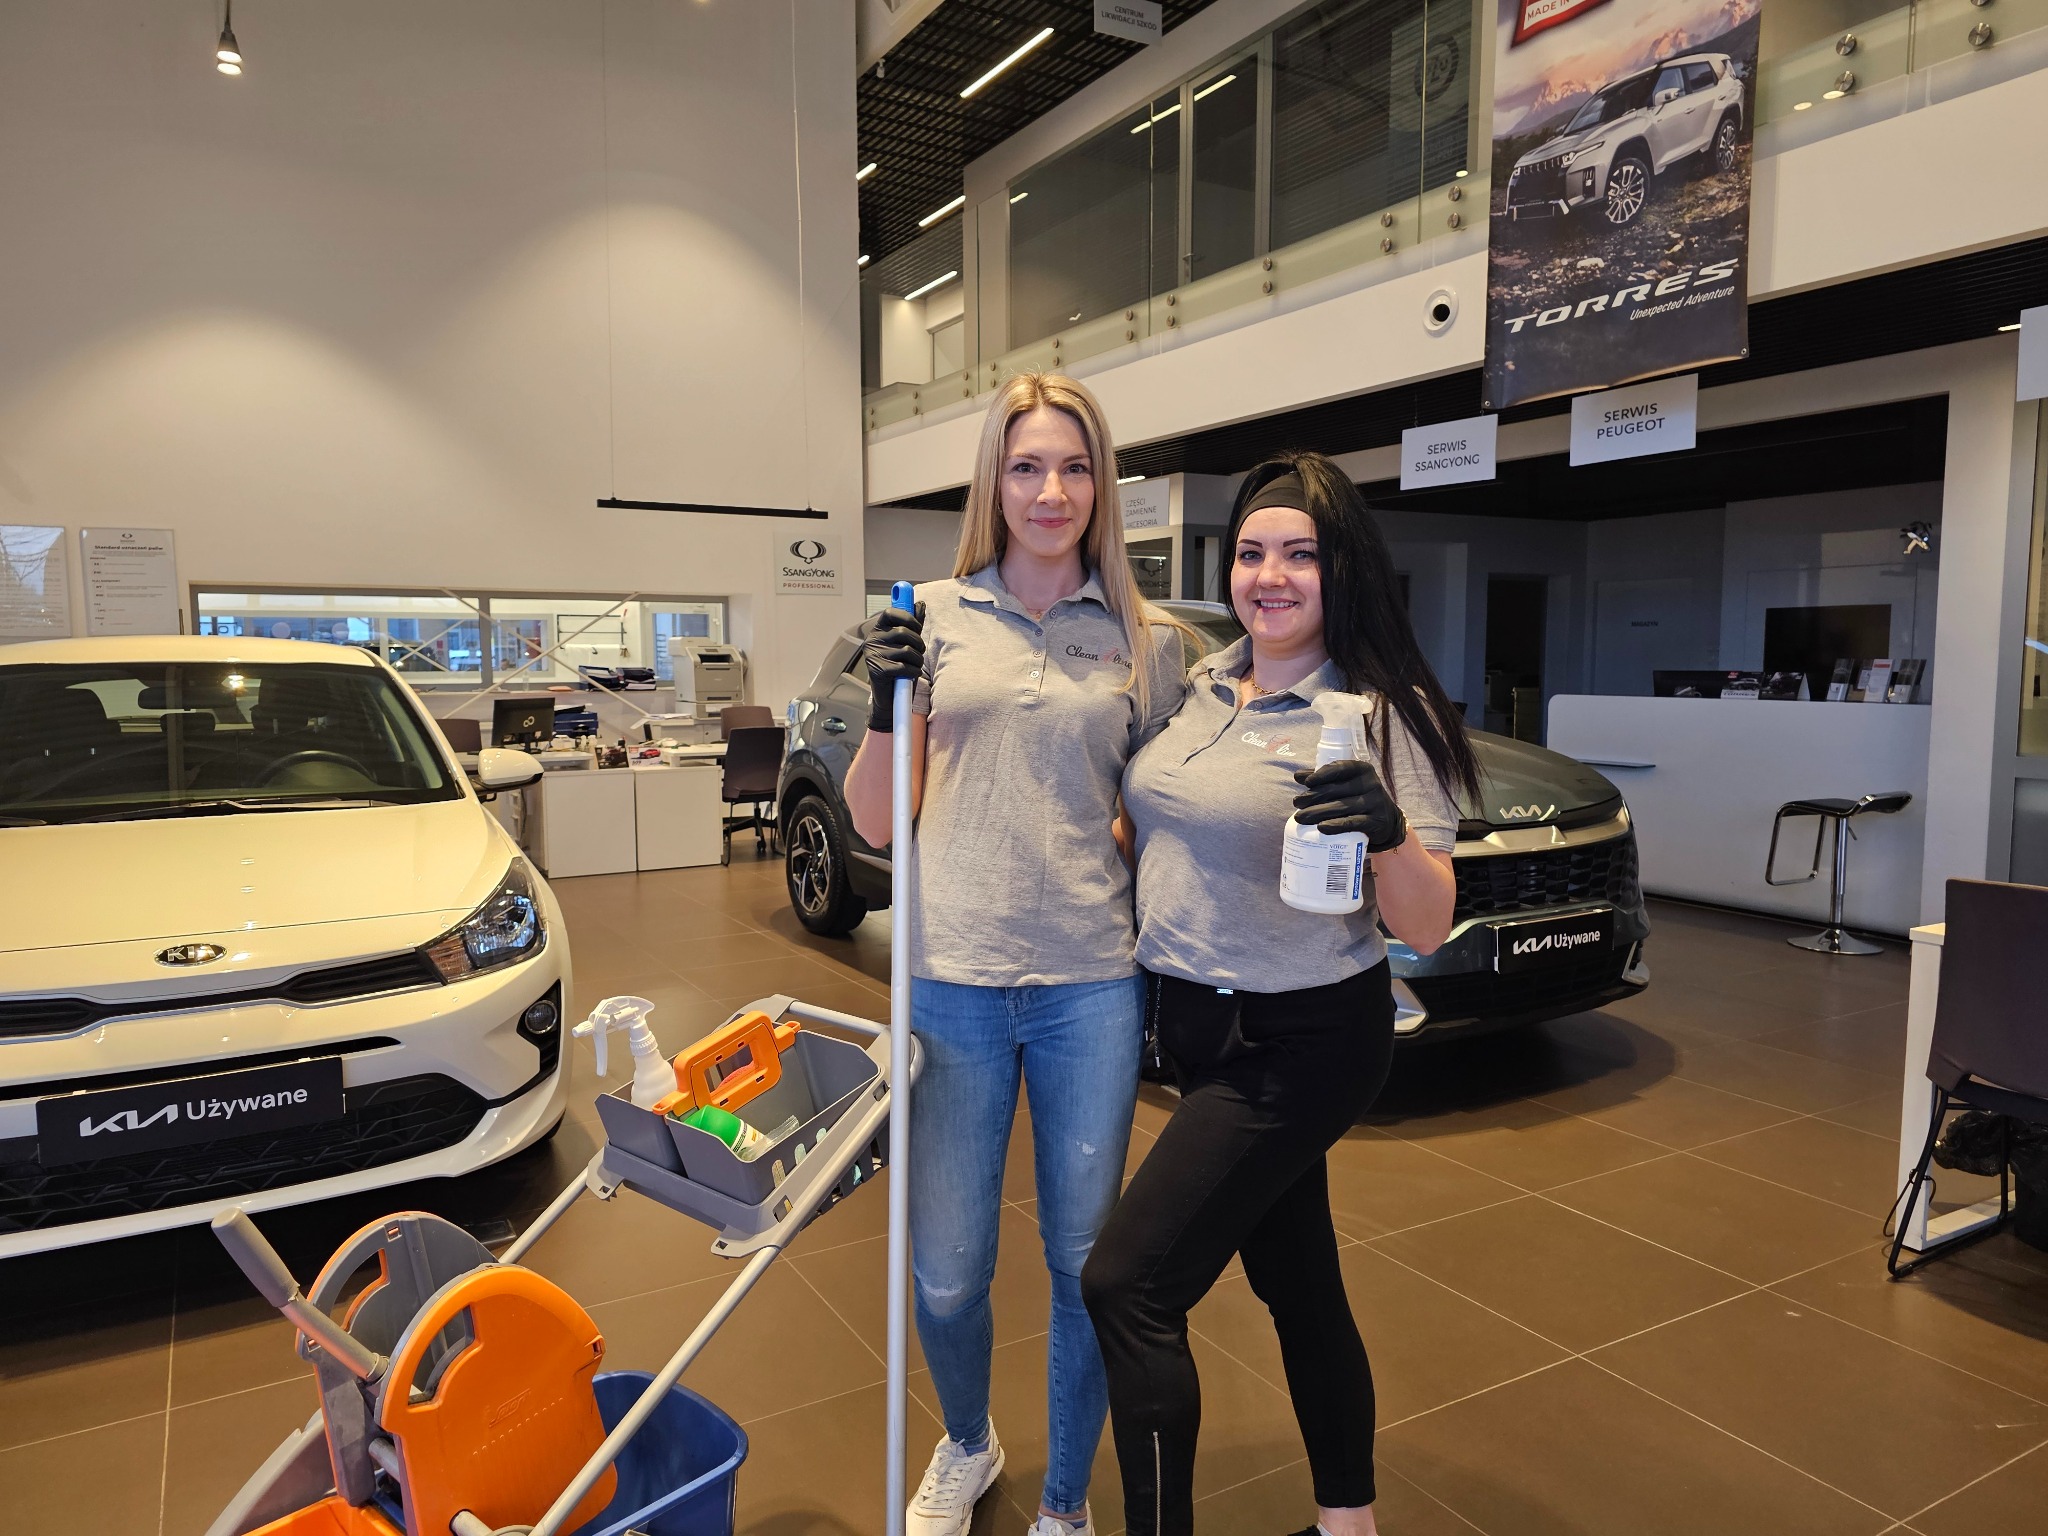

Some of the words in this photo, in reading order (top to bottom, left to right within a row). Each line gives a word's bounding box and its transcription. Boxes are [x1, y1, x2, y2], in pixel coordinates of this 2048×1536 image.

[1101, 10, 1136, 24] LIKWIDACJI
[1114, 5, 1144, 18] CENTRUM
[1527, 2, 1556, 21] MADE
[1503, 257, 1739, 334] TORRES
[1629, 298, 1683, 321] Unexpected
[1683, 285, 1735, 307] Adventure
[1604, 402, 1658, 423] SERWIS
[1596, 417, 1666, 440] PEUGEOT
[1426, 439, 1467, 455] SERWIS
[1414, 453, 1480, 472] SSANGYONG
[1125, 497, 1146, 508] CZĘŚCI
[1125, 505, 1157, 517] ZAMIENNE
[782, 582, 835, 590] PROFESSIONAL
[1065, 644, 1099, 662] Clean
[1512, 934, 1552, 955] KIA
[1553, 929, 1601, 950] Używane
[79, 1103, 179, 1137] KIA
[186, 1087, 308, 1120] Używane
